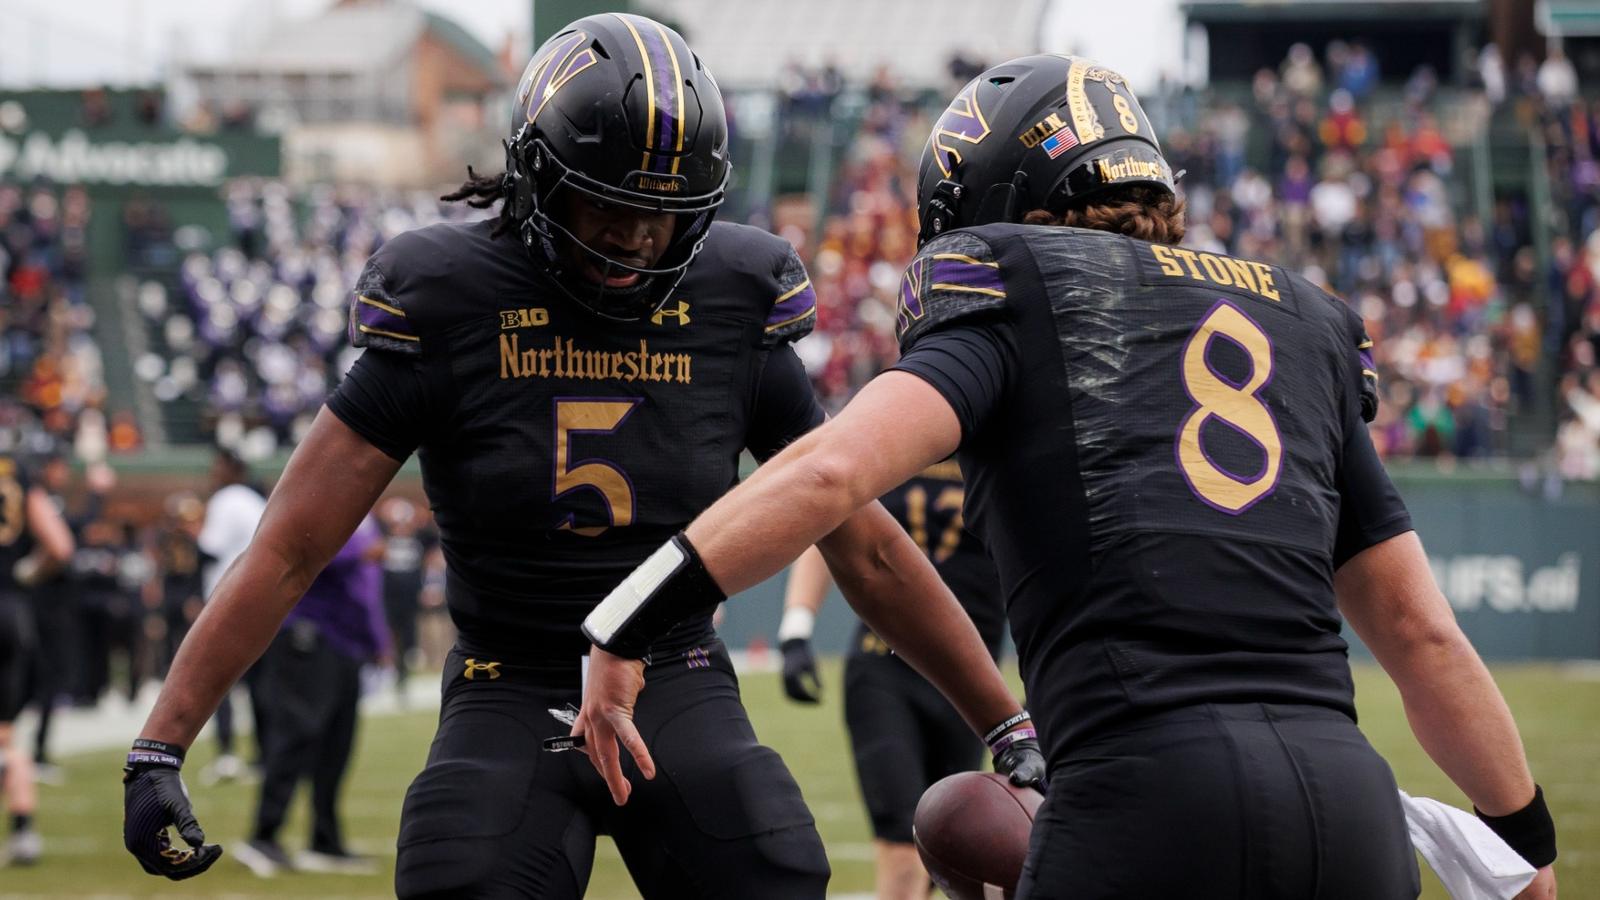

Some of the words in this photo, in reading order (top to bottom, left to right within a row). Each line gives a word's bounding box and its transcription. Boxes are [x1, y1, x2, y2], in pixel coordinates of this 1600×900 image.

[1113, 93, 1139, 135] 8
[638, 176, 680, 192] Wildcats
[1151, 244, 1281, 302] STONE
[499, 332, 692, 385] Northwestern
[1174, 299, 1284, 516] 8
[552, 396, 645, 538] 5
[150, 743, 167, 751] PUT
[161, 755, 177, 765] Love
